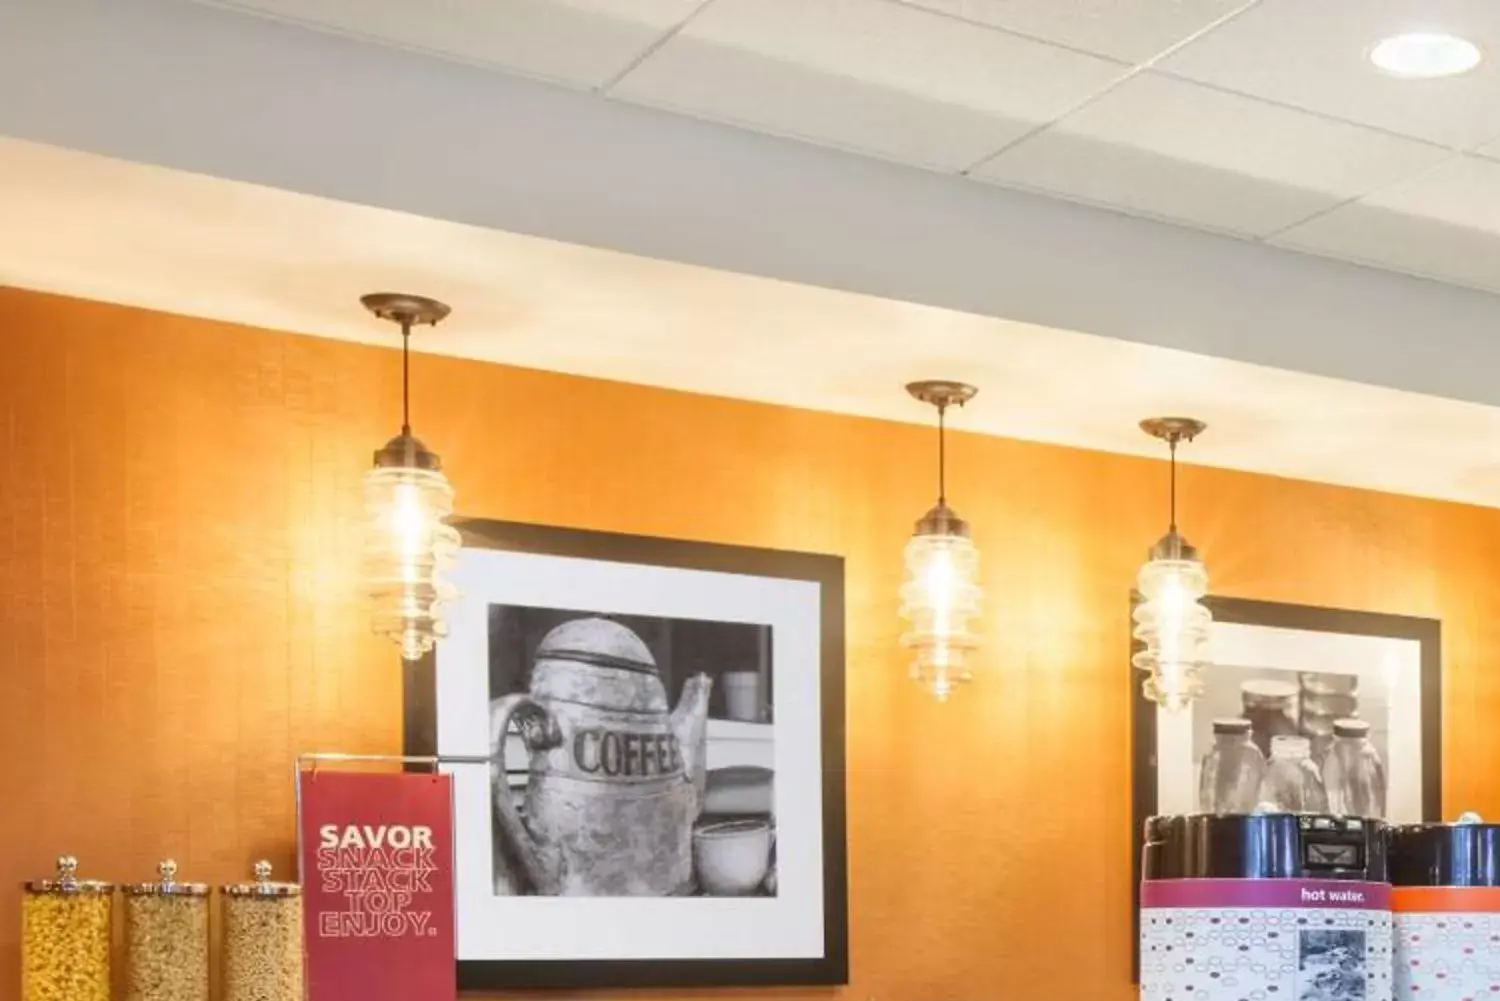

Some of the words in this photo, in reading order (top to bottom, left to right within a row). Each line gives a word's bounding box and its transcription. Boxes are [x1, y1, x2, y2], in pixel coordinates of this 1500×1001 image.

[573, 729, 680, 777] COFFEE
[319, 825, 433, 849] SAVOR
[316, 846, 438, 871] SNACK
[321, 867, 433, 892] STACK
[343, 889, 412, 914] TOP
[1301, 887, 1326, 902] hot
[319, 911, 438, 937] ENJOY.
